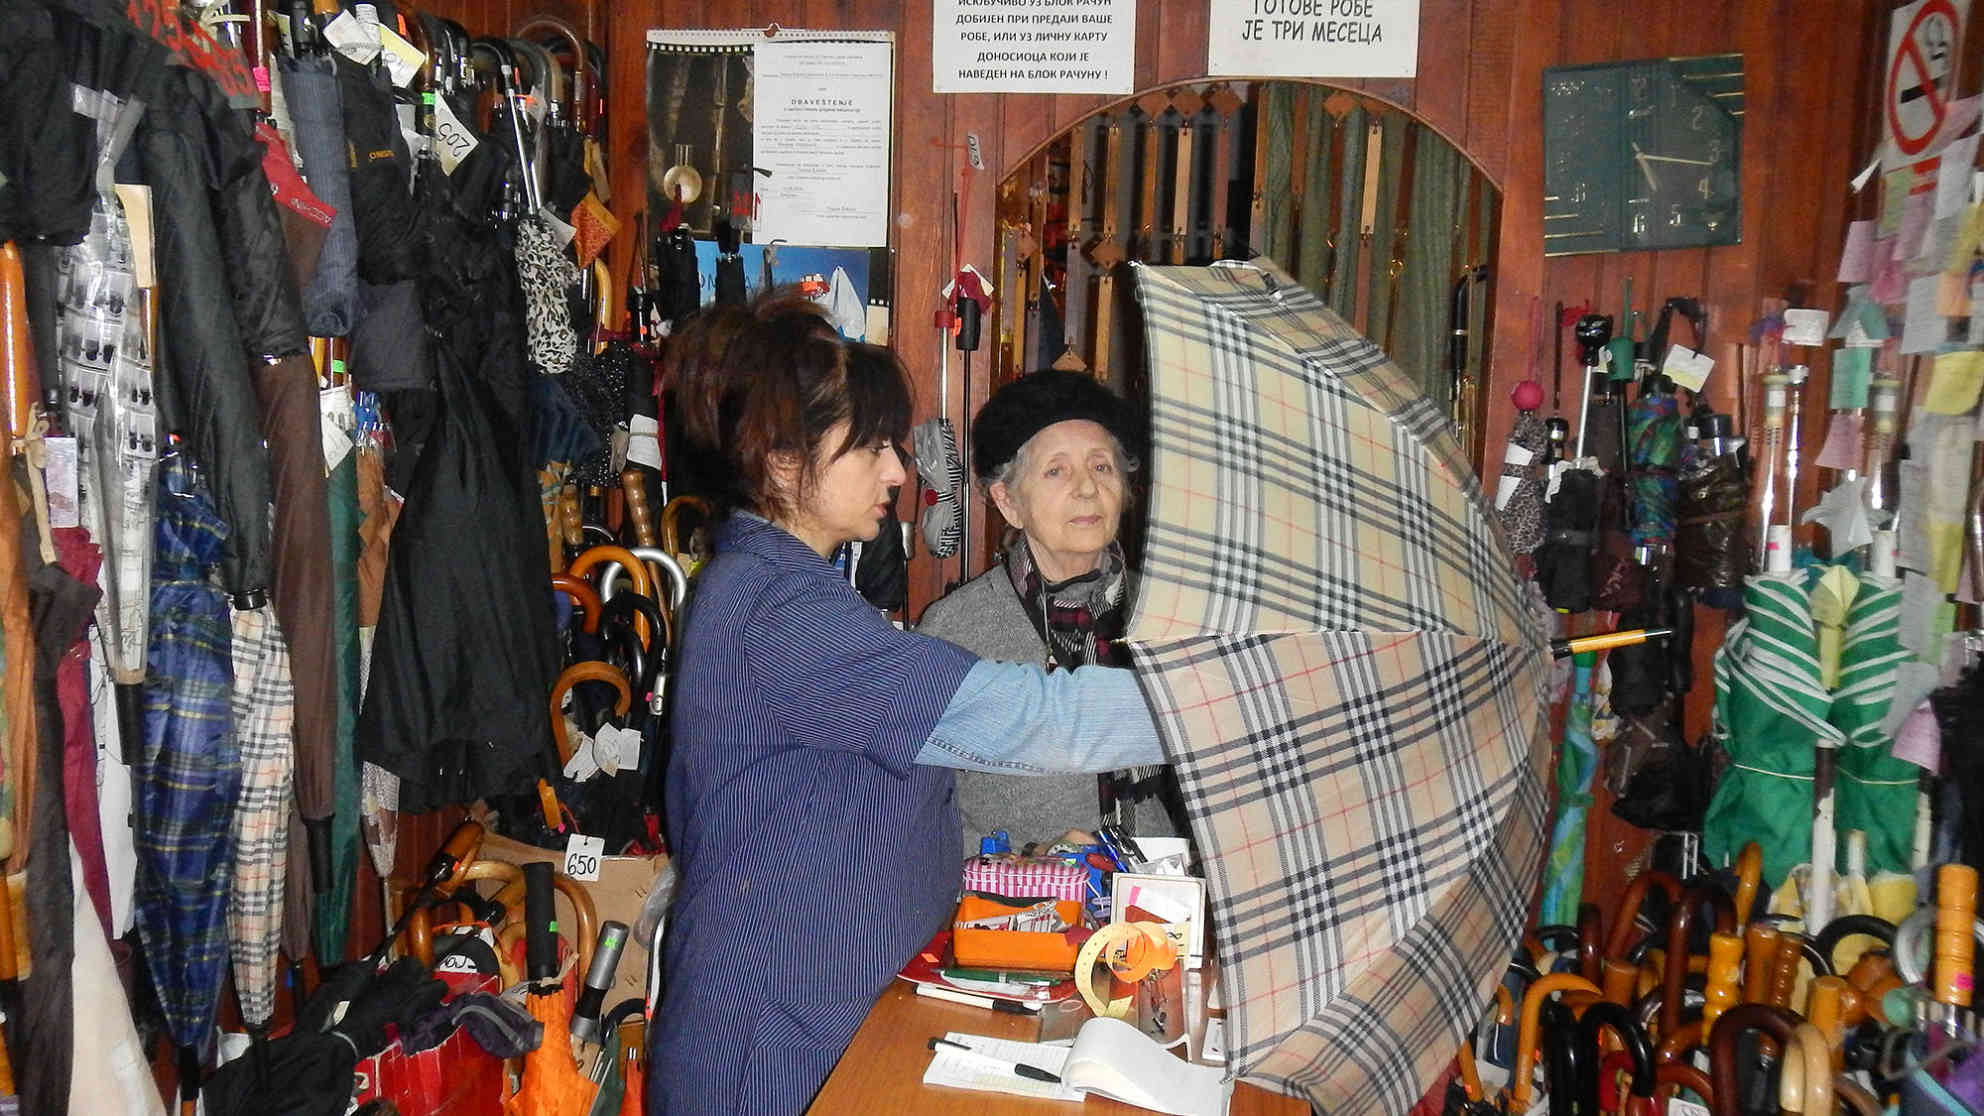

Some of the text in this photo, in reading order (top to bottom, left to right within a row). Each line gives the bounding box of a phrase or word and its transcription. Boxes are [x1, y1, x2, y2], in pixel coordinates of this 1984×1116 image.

[956, 15, 1112, 24] ДОБИЈЕН ПРИ ПРЕДАЈИ ВАШЕ
[961, 32, 1107, 42] РОБЕ, ИЛИ УЗ ЛИЧНУ КАРТУ
[1242, 19, 1383, 45] ЈЕ ТРИ МЕСЕЦА
[977, 52, 1089, 63] ДОНОСИОЦА КОЈИ ЈЕ
[959, 69, 1007, 80] НАВЕДЕН
[1010, 70, 1025, 79] НА
[1028, 70, 1056, 79] БЛОК
[1060, 70, 1101, 79] РАЧУНУ
[567, 853, 597, 875] 650
